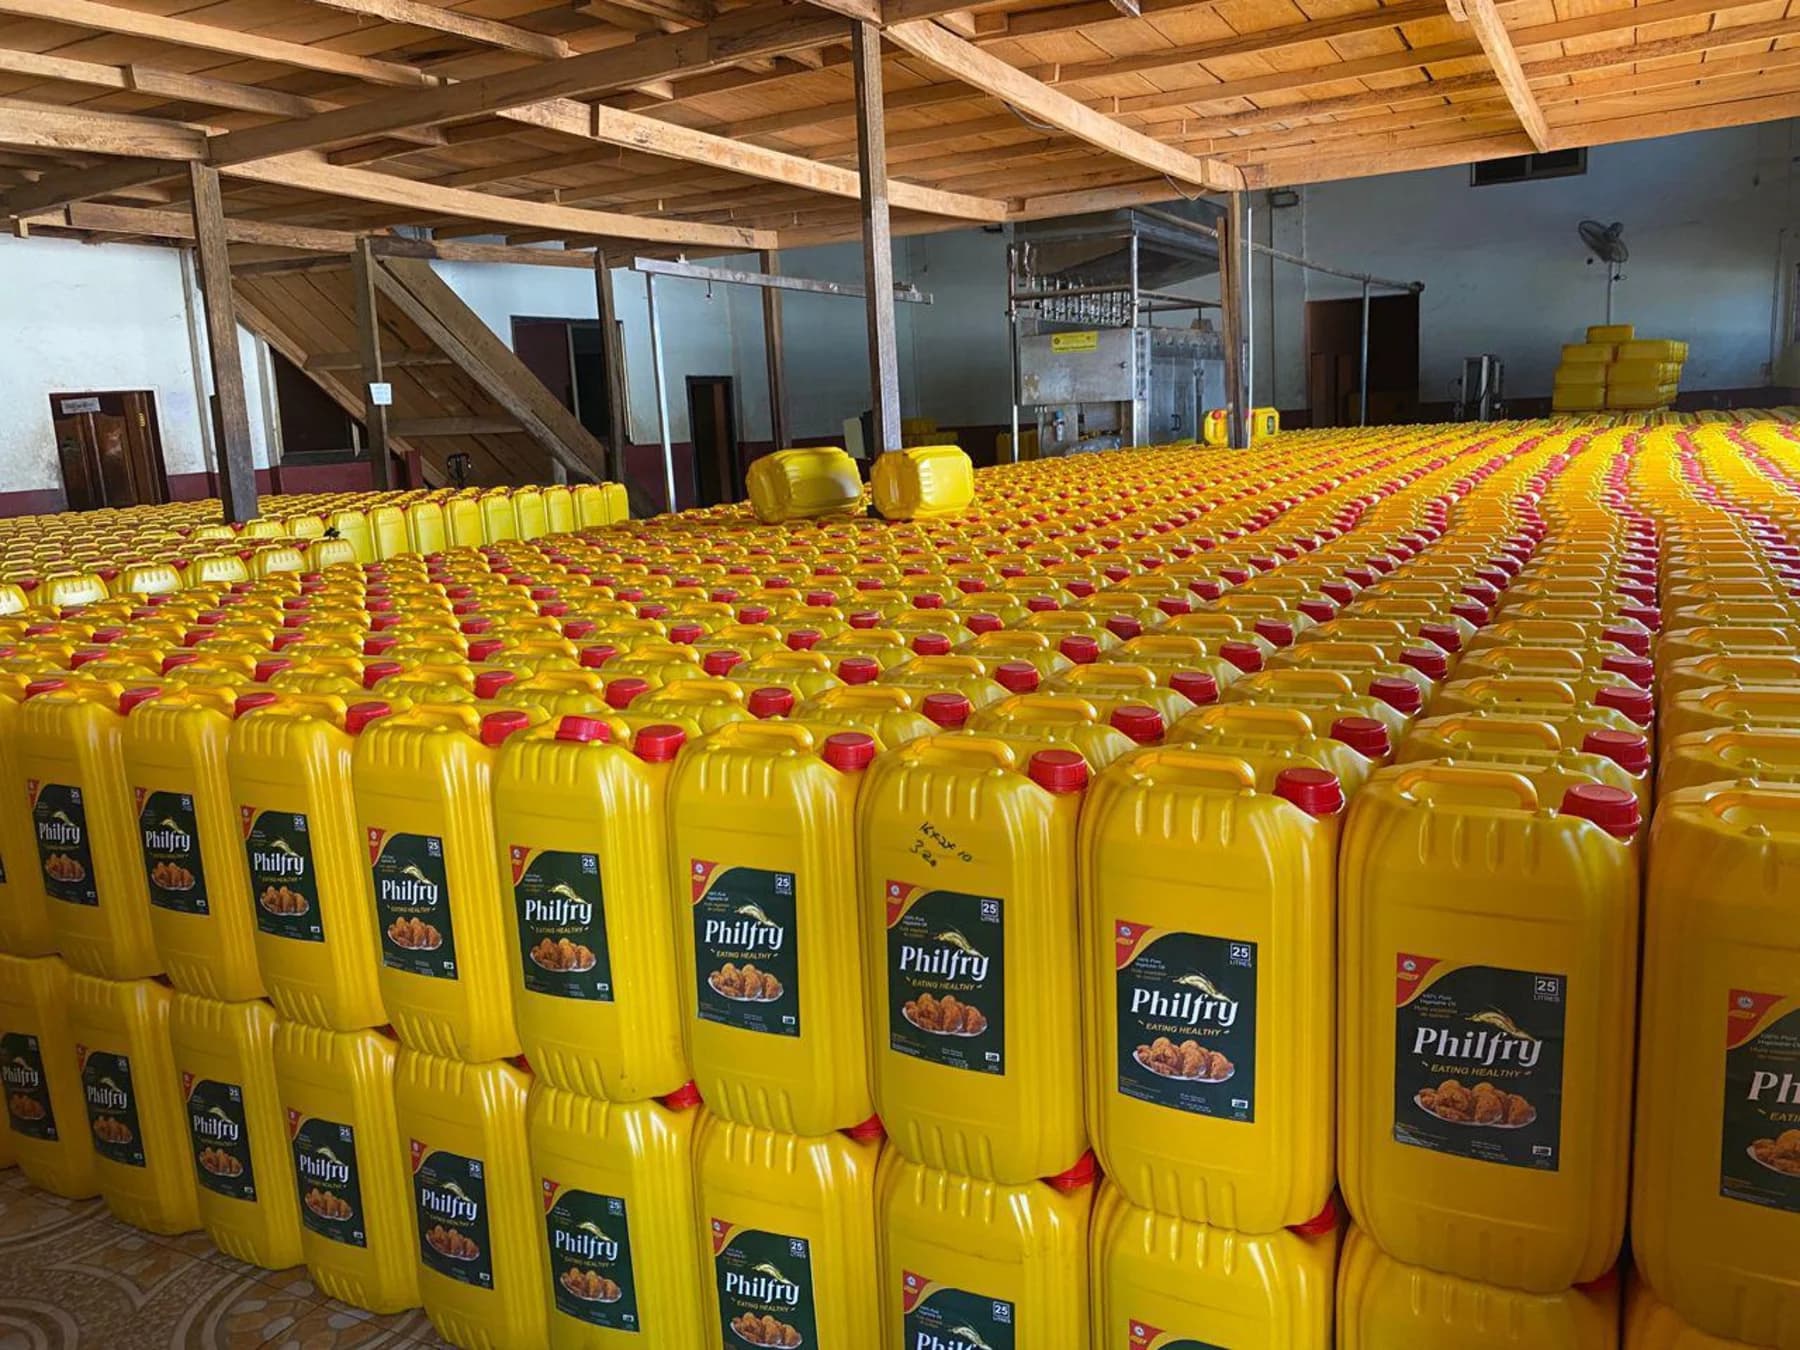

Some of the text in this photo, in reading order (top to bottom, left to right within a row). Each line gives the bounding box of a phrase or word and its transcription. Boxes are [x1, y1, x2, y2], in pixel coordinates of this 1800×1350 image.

[39, 822, 80, 843] Philfry
[145, 831, 190, 852] Philfry
[428, 841, 439, 850] 25
[254, 853, 304, 875] Philfry
[583, 858, 594, 867] 25
[382, 879, 438, 905] Philfry
[777, 877, 790, 887] 25
[525, 899, 592, 926] Philfry
[983, 903, 997, 914] 25
[704, 919, 783, 950] Philfry
[716, 950, 771, 960] EATING HEALTHY
[1232, 946, 1249, 958] 25
[900, 945, 989, 981] Philfry
[912, 979, 975, 992] EATING HEALTHY
[1537, 980, 1556, 992] 25
[1131, 988, 1238, 1027] Philfry
[1146, 1022, 1222, 1036] EATING HEALTHY
[1413, 1026, 1542, 1068] Philfry
[1431, 1063, 1522, 1078] EATING HEALTHY
[1748, 1071, 1800, 1104] Ph
[193, 1115, 239, 1140] Philfry
[1770, 1111, 1800, 1123] EATI
[300, 1154, 349, 1183] Philfry
[421, 1188, 477, 1220] Philfry
[556, 1230, 618, 1261] Philfry
[791, 1241, 803, 1251] 25
[726, 1272, 799, 1305] Philfry
[995, 1304, 1008, 1315] 25
